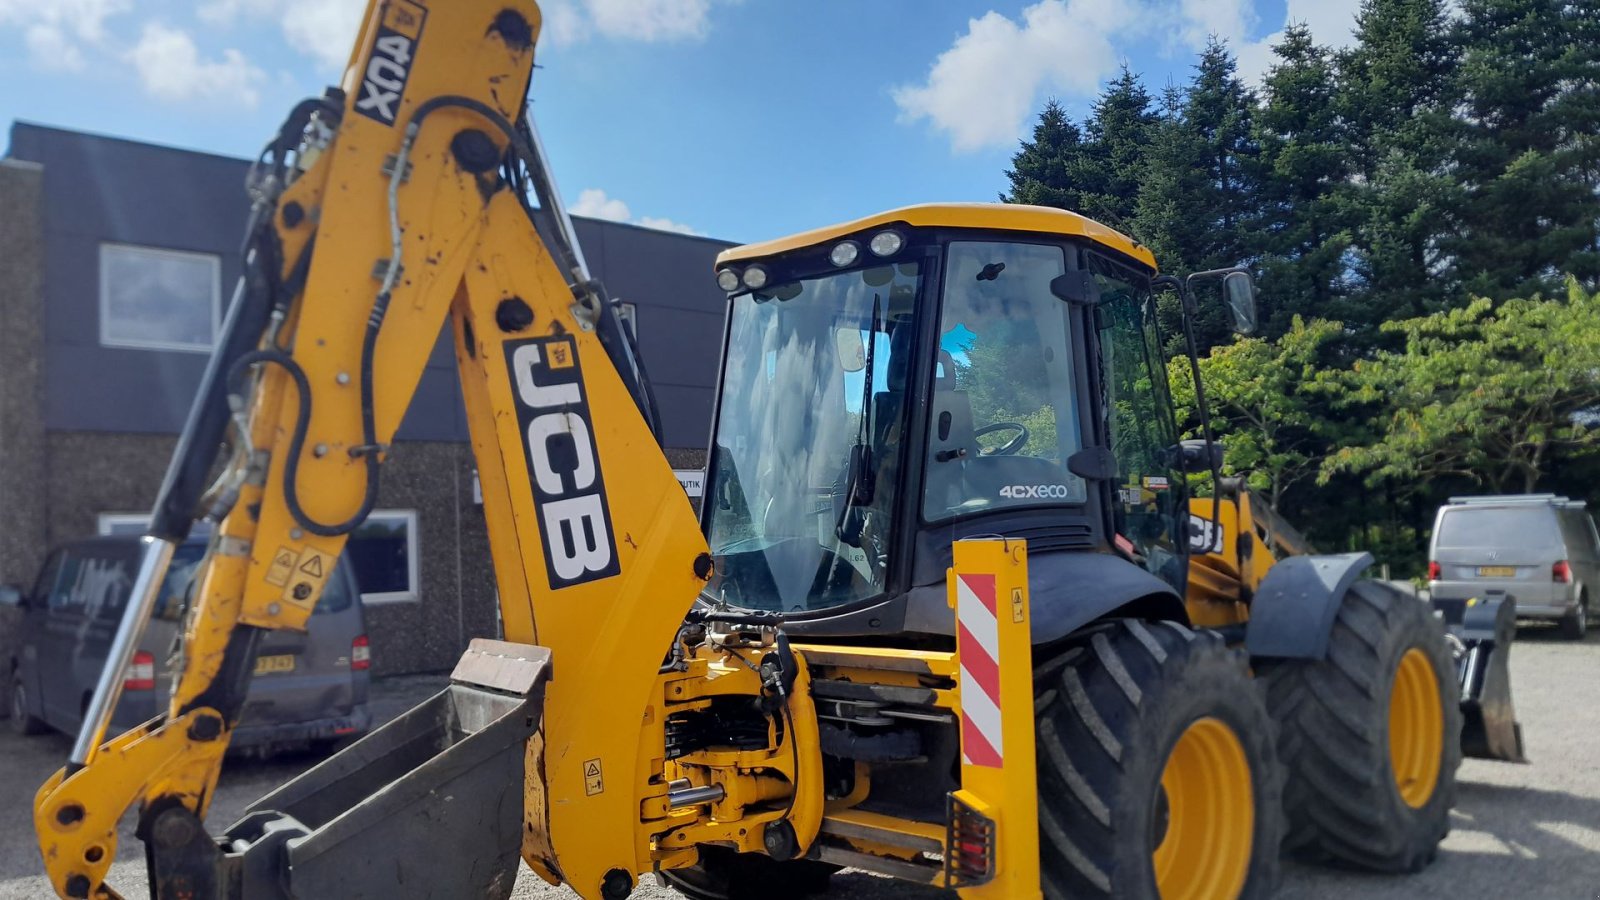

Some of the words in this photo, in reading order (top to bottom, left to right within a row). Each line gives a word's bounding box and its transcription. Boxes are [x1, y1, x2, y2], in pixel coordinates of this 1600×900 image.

[357, 35, 411, 120] 4CX
[513, 343, 611, 580] JCB
[680, 480, 701, 489] UTIK
[999, 484, 1068, 499] 4CXeco
[1189, 514, 1223, 553] CB
